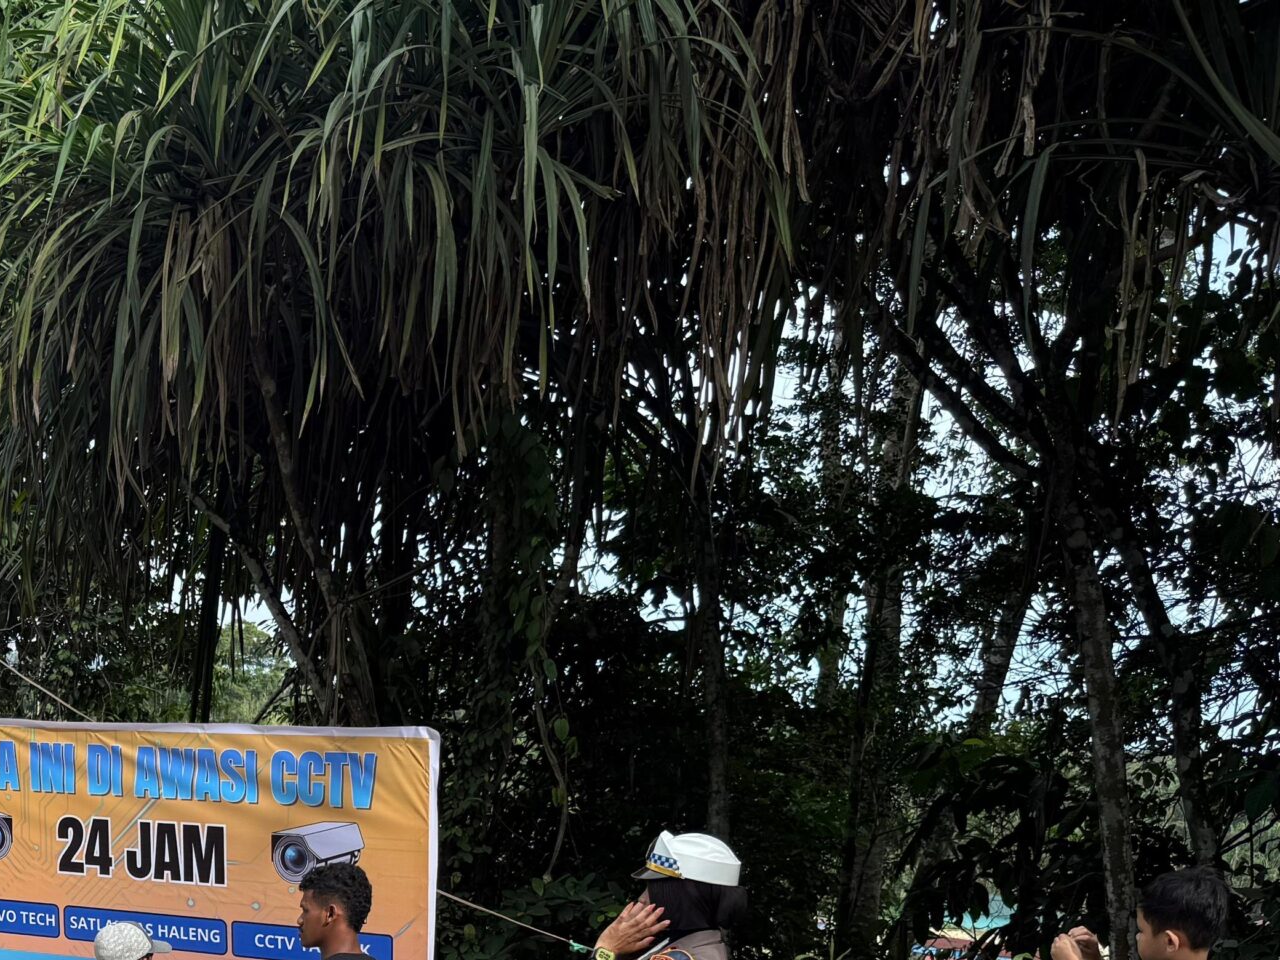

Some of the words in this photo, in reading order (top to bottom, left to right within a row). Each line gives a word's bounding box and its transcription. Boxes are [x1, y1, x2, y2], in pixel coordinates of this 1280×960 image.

[29, 742, 76, 794] INI
[87, 744, 123, 797] DI
[134, 746, 260, 804] AWASI
[270, 749, 377, 810] CCTV
[56, 815, 114, 878] 24
[123, 819, 227, 887] JAM
[20, 911, 56, 927] TECH
[157, 924, 221, 943] HALENG
[254, 933, 295, 951] CCTV
